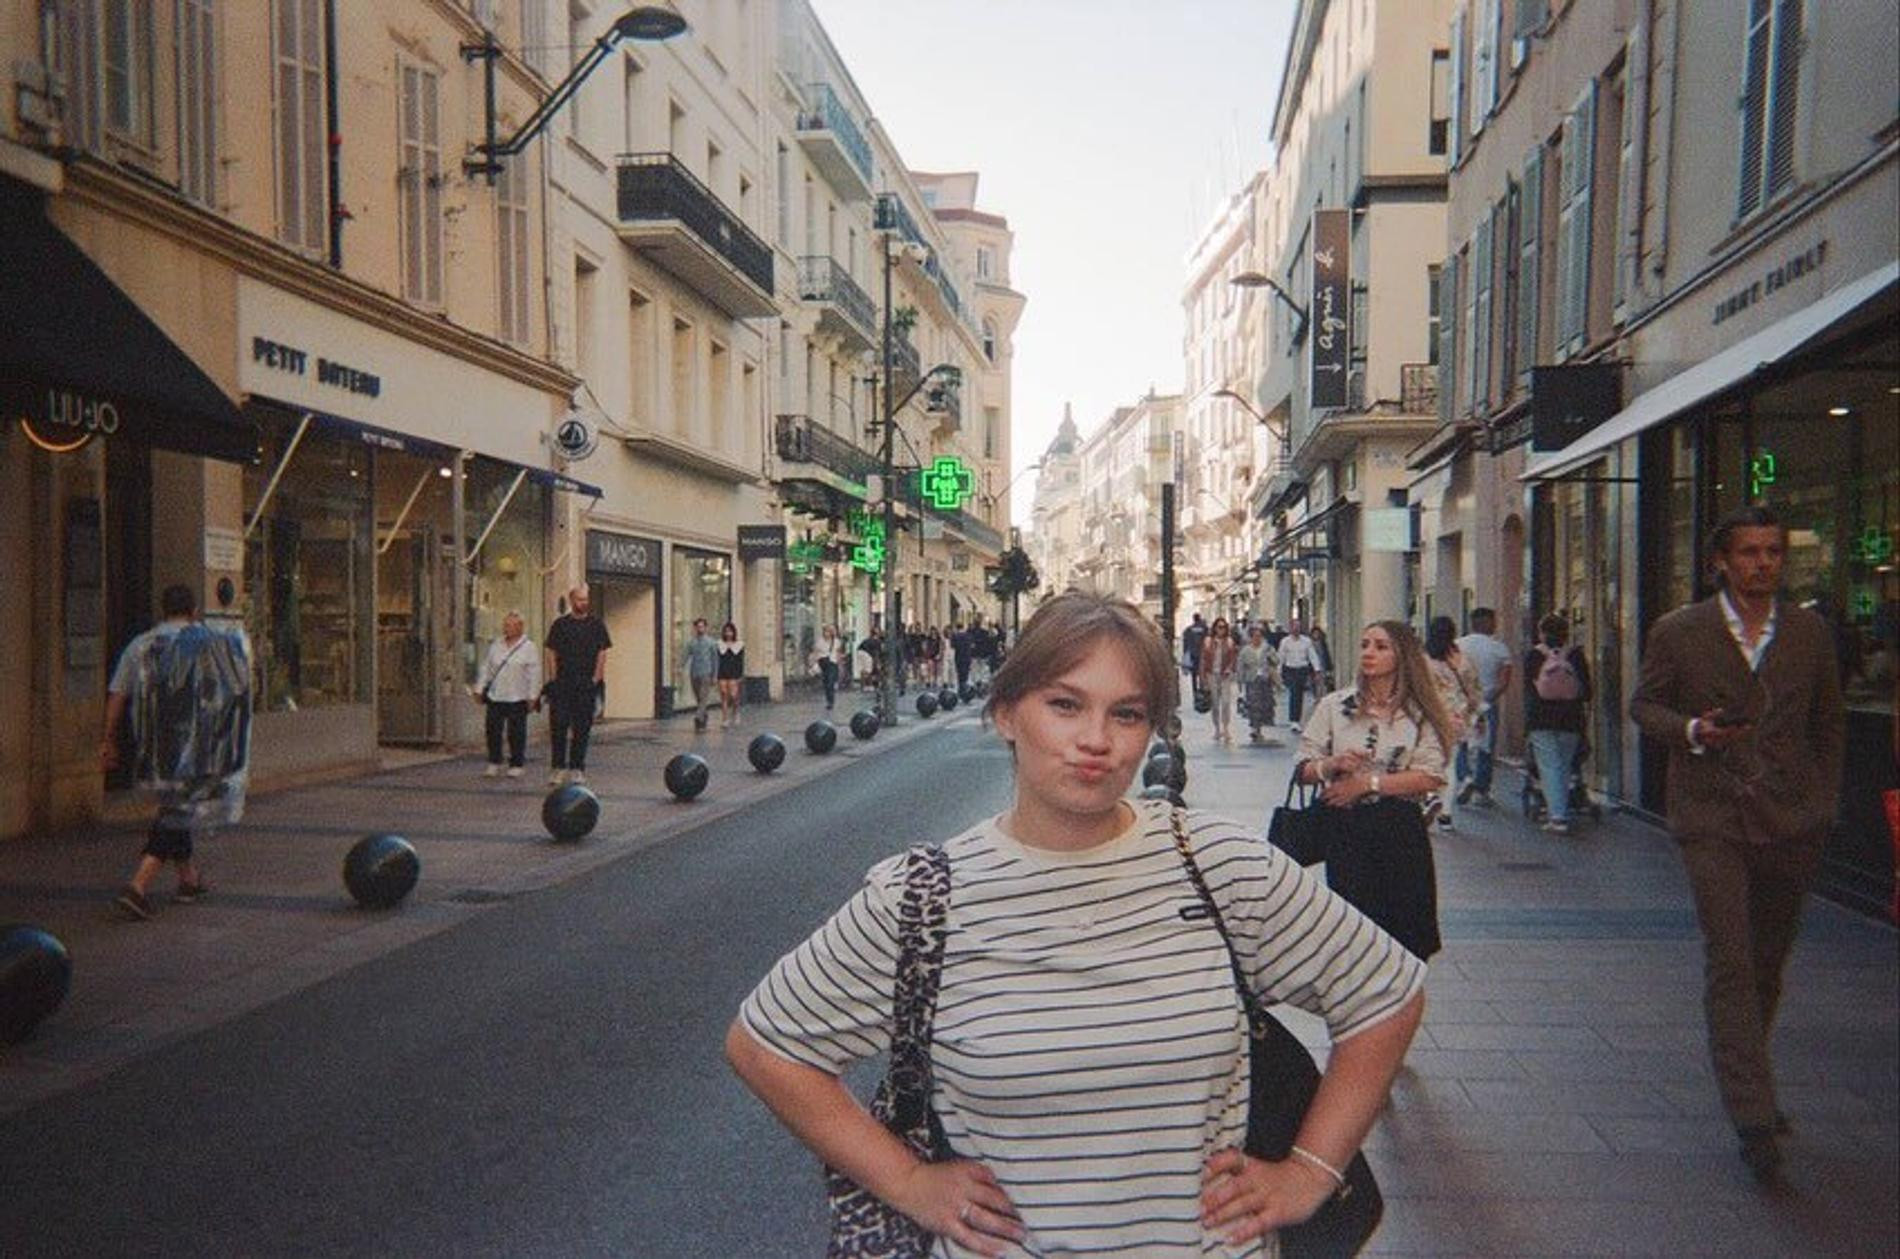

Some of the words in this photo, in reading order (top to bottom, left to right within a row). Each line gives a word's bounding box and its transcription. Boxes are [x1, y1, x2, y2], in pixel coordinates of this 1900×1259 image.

[253, 336, 307, 375] PETIT
[317, 357, 380, 398] BATEAU
[600, 538, 648, 569] MANGO
[741, 536, 782, 547] MANGO
